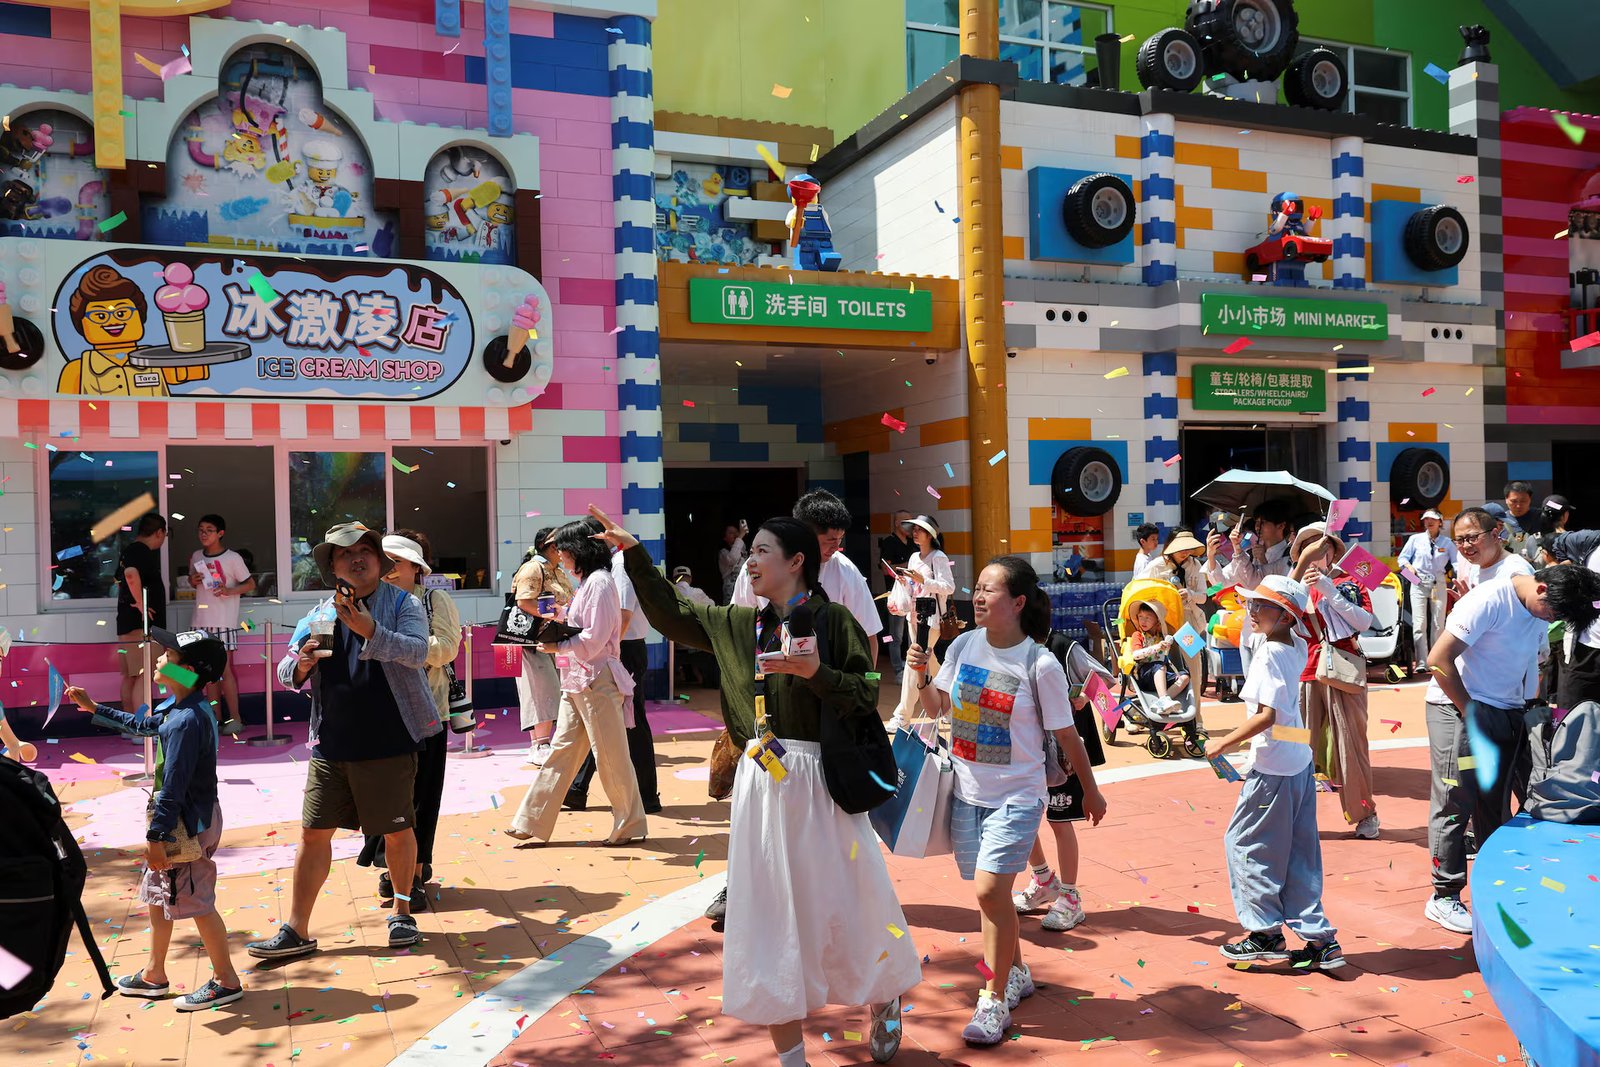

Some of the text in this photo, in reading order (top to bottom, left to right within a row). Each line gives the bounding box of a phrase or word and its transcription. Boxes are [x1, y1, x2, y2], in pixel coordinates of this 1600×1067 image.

[223, 283, 448, 351] 冰激凌店
[765, 294, 906, 318] 洗手间 TOILETS
[1218, 304, 1376, 328] 小小市场 MINI MARKET
[257, 357, 442, 380] ICE CREAM SHOP
[1210, 371, 1313, 388] 童车/轮椅/包裹提取
[1233, 397, 1292, 407] PACKAGE PICKUP
